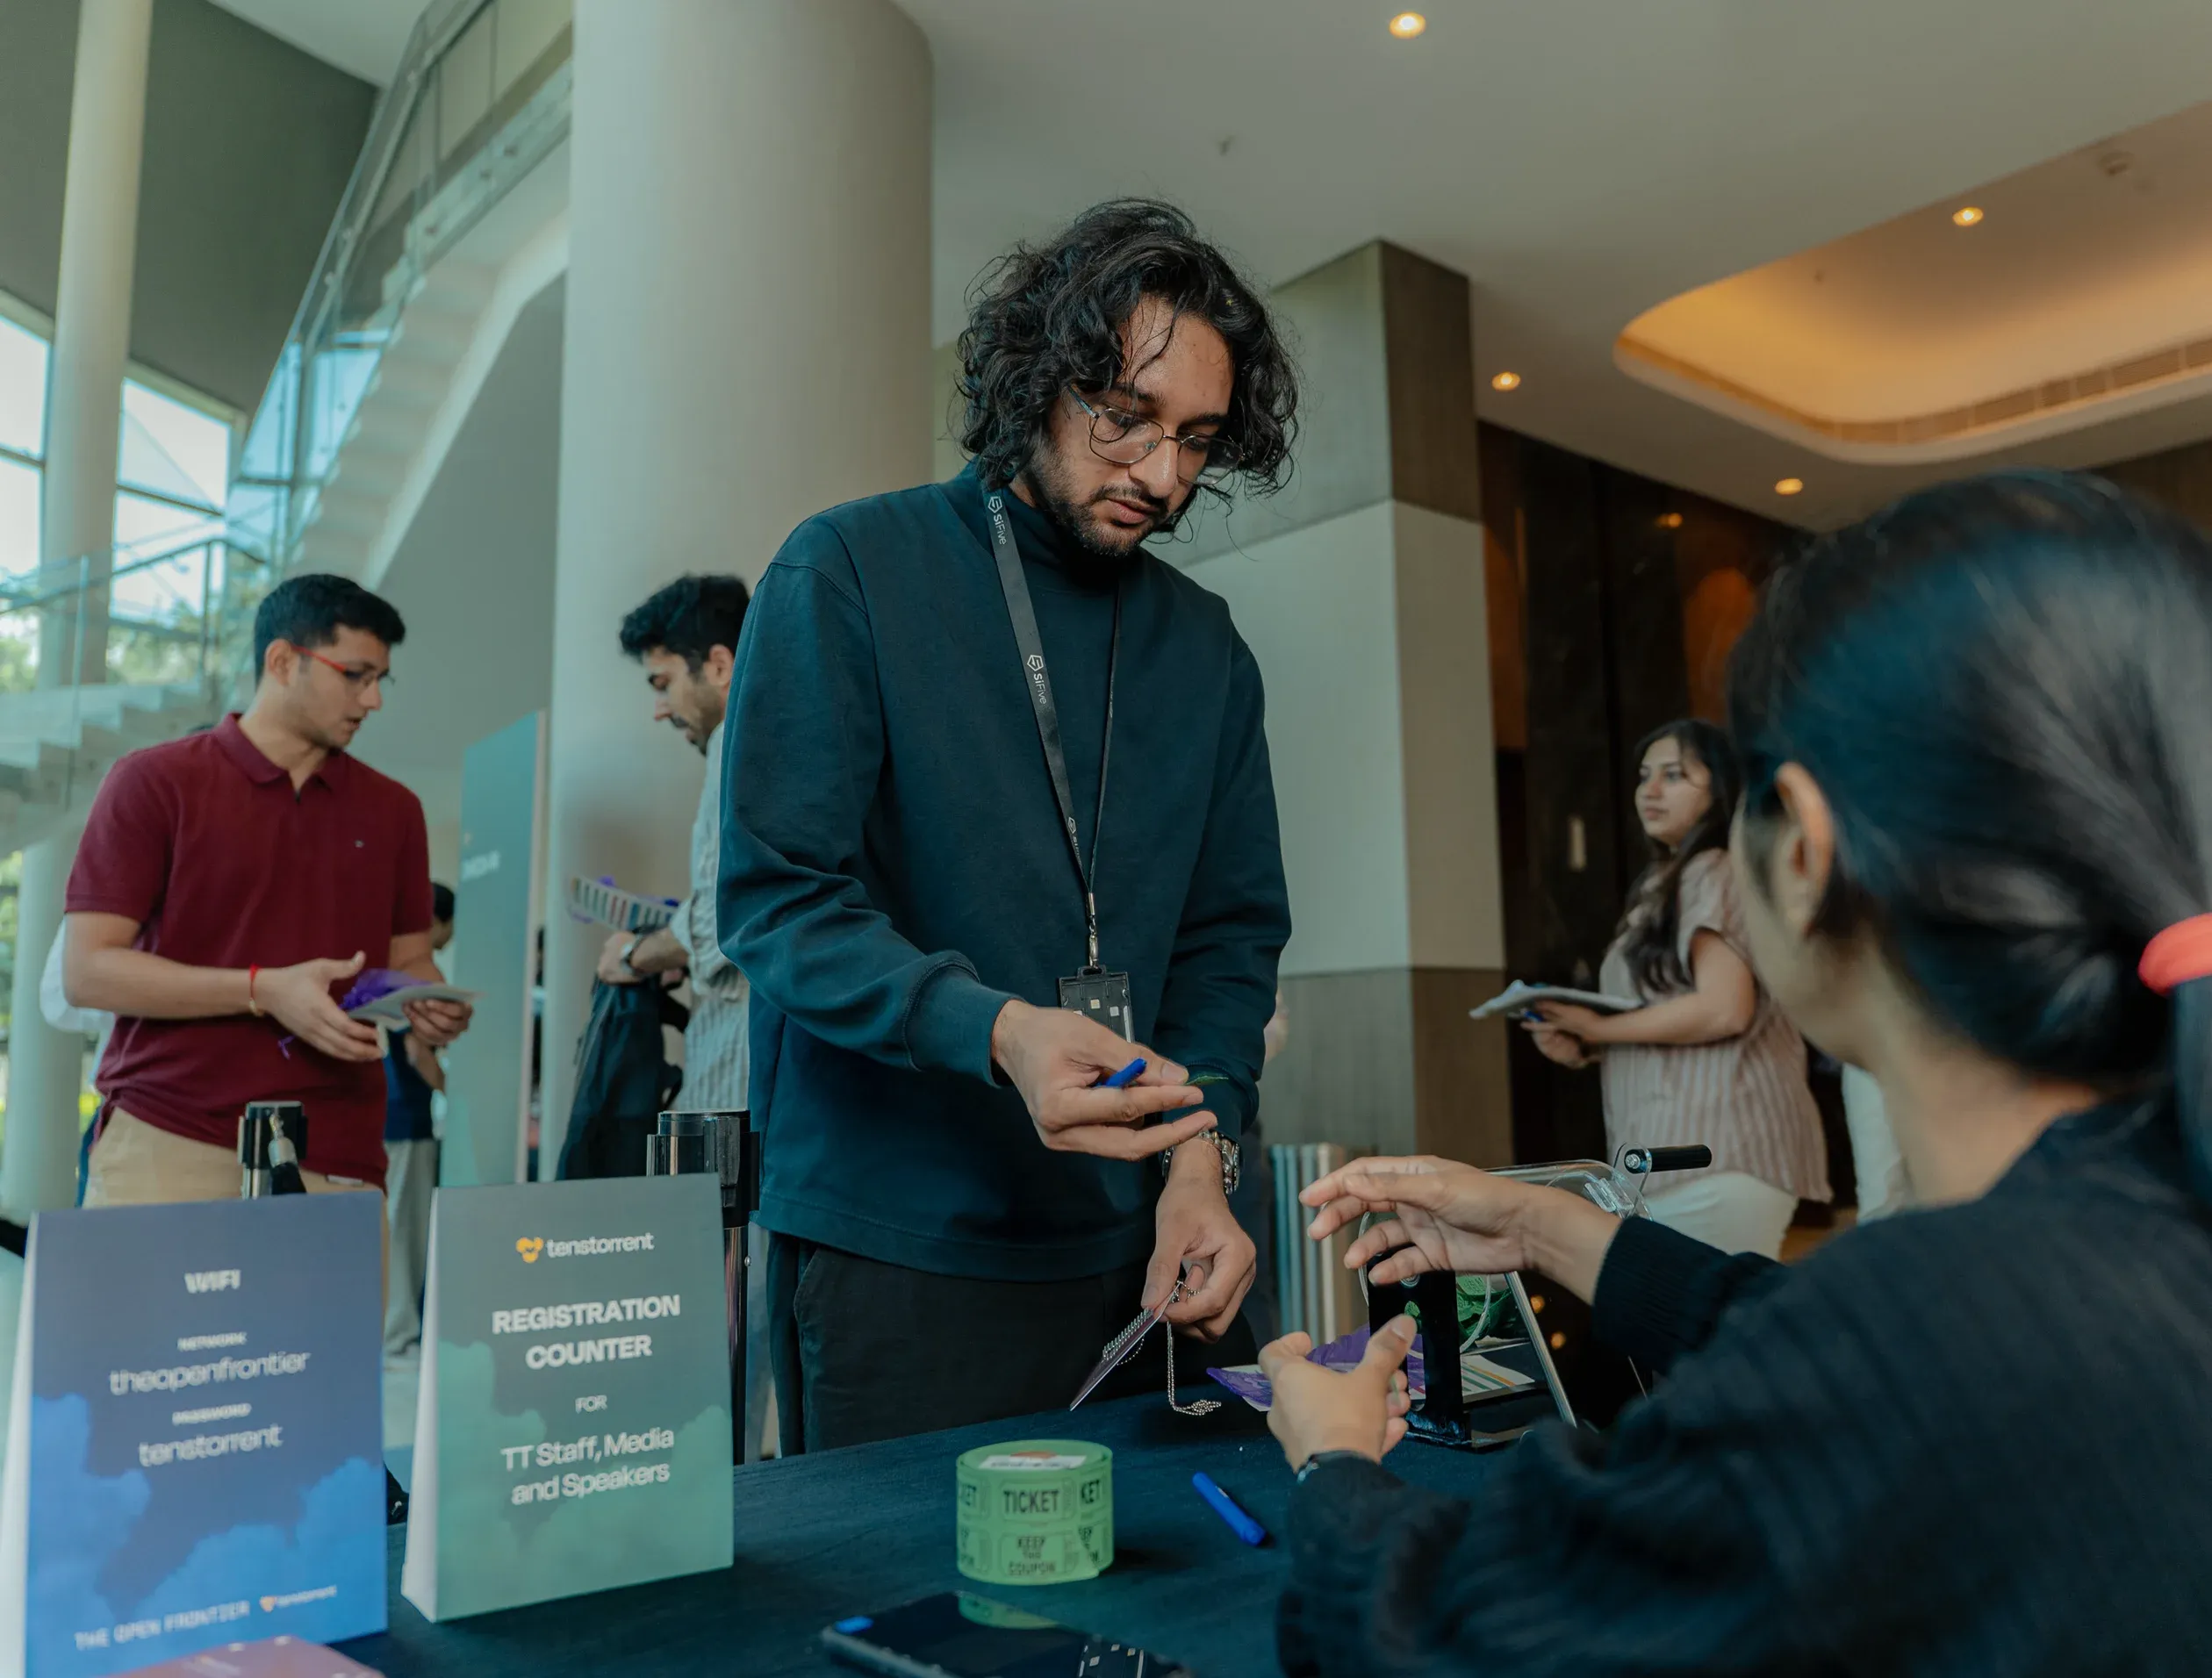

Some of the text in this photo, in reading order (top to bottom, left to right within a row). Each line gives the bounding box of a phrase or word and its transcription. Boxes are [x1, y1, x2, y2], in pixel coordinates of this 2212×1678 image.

[993, 513, 1007, 545] SiFive
[1033, 672, 1047, 705] SiFive
[546, 1232, 655, 1258] tenstorrent
[184, 1269, 241, 1294] WIFI
[492, 1294, 680, 1334] REGISTRATION
[525, 1335, 653, 1369] COUNTER
[109, 1351, 312, 1395] theopenfrontier
[575, 1395, 607, 1414] FOR
[139, 1423, 284, 1467] tenstorrent
[500, 1427, 675, 1471] TT Staff, Media
[511, 1462, 671, 1505] and Speakers
[1003, 1489, 1059, 1514] TICKET
[75, 1627, 110, 1651] THE
[164, 1600, 251, 1631] FRONTIER
